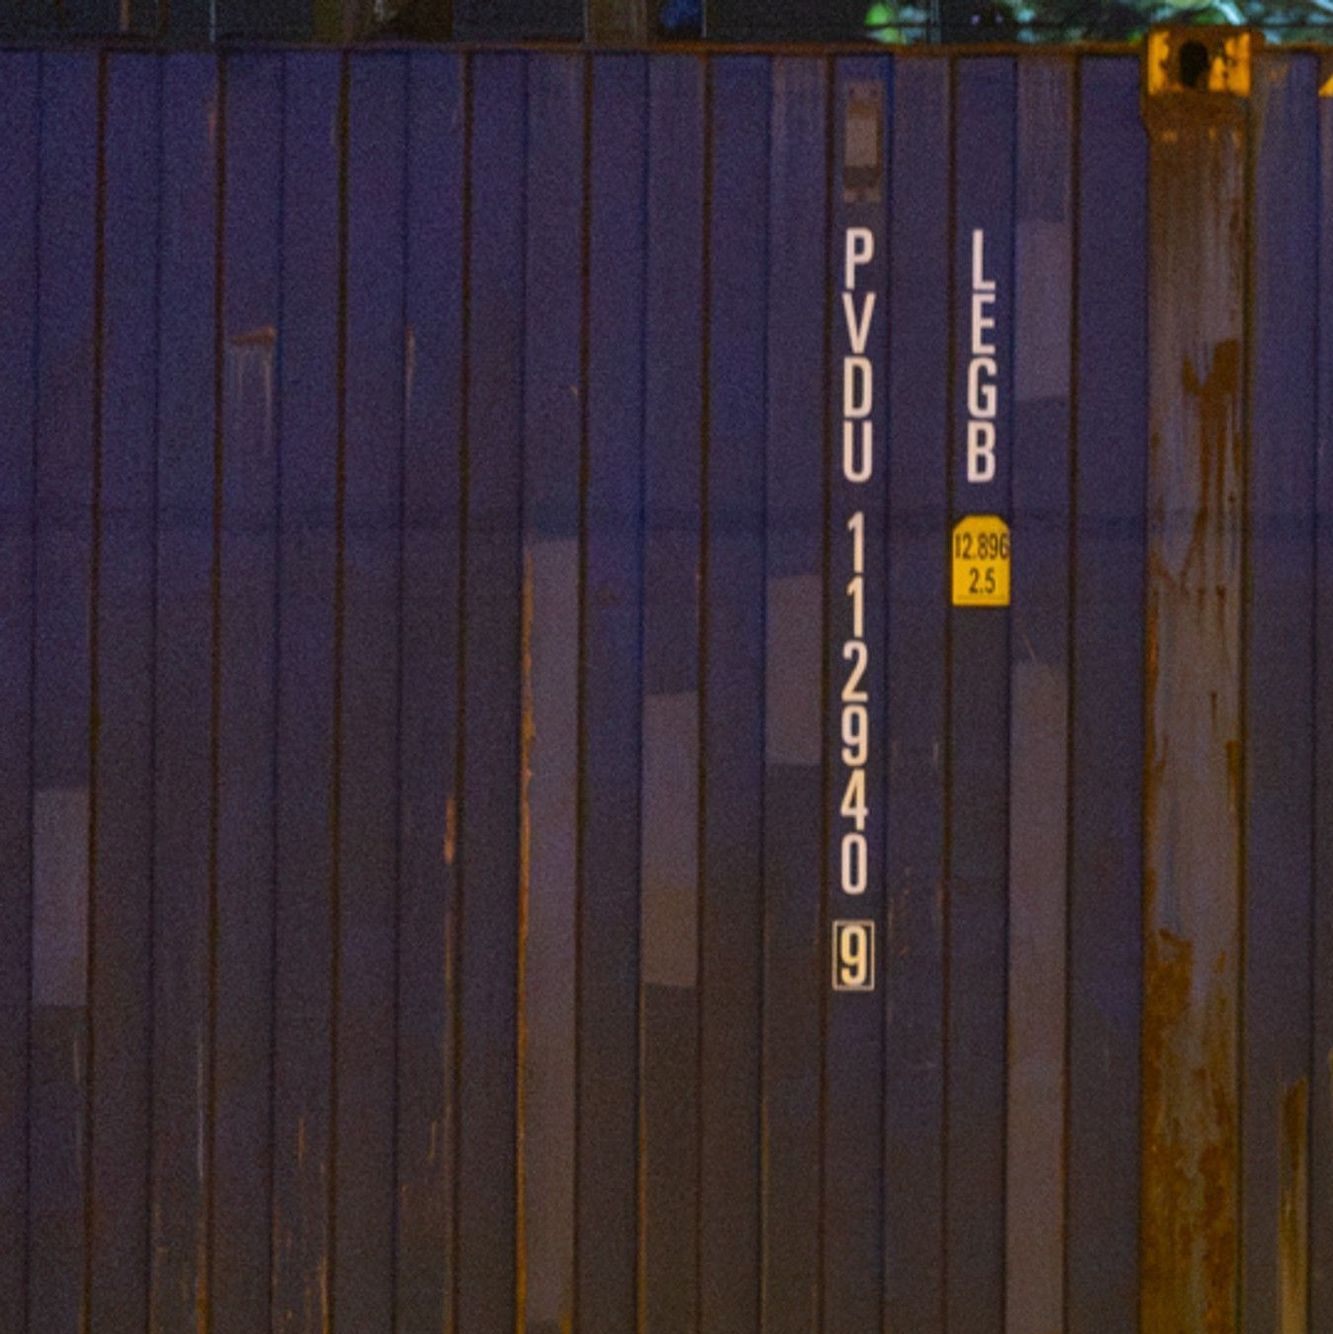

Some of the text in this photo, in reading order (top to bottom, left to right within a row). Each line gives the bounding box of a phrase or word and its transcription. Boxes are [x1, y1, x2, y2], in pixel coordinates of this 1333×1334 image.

[966, 229, 998, 483] LEGB
[839, 226, 876, 988] PVDU 112940 9
[968, 567, 996, 594] 2.5
